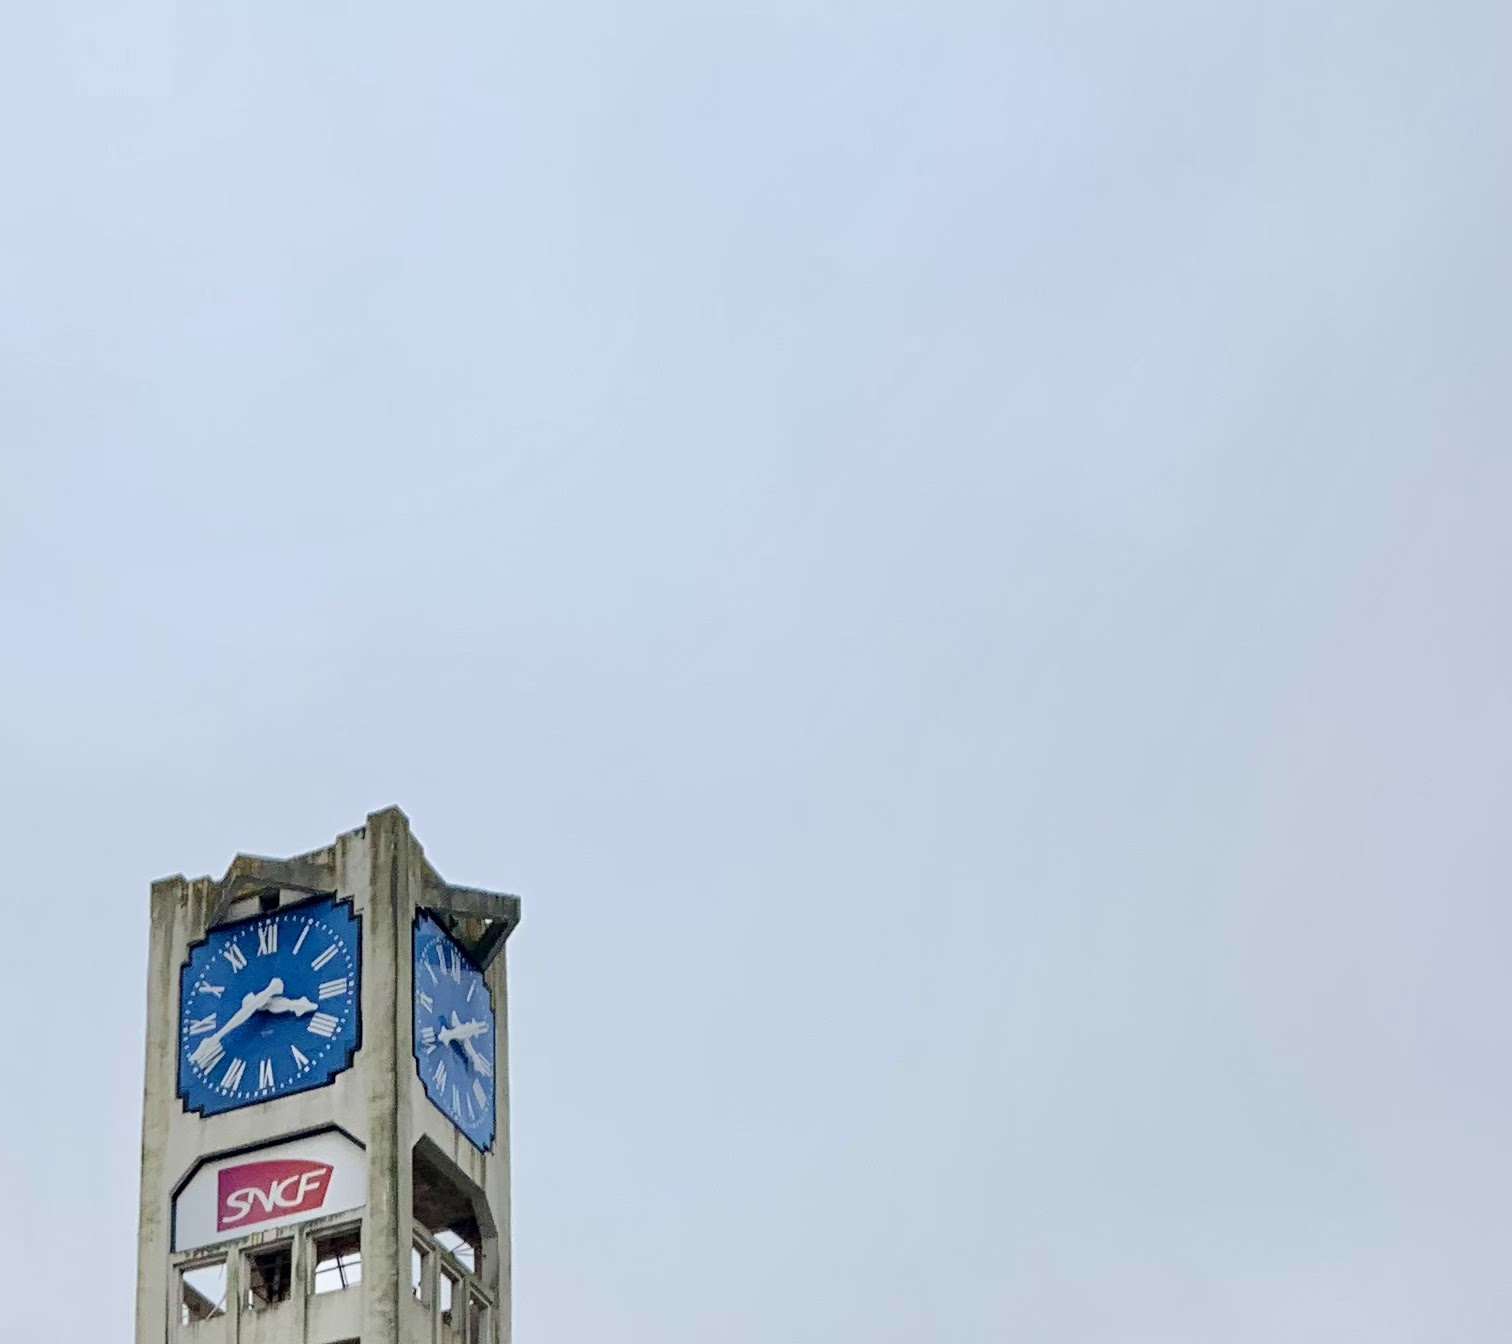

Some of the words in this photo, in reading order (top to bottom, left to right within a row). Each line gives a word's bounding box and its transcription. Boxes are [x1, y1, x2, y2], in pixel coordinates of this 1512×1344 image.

[257, 923, 278, 956] XII
[292, 925, 310, 955] I
[223, 944, 247, 973] XI
[311, 944, 339, 971] II
[199, 981, 225, 998] X
[319, 977, 347, 1000] III
[190, 1012, 217, 1035] IX
[307, 1012, 339, 1038] IIII
[291, 1044, 309, 1070] V
[260, 1058, 274, 1089] VI
[222, 1168, 327, 1224] SNCF
